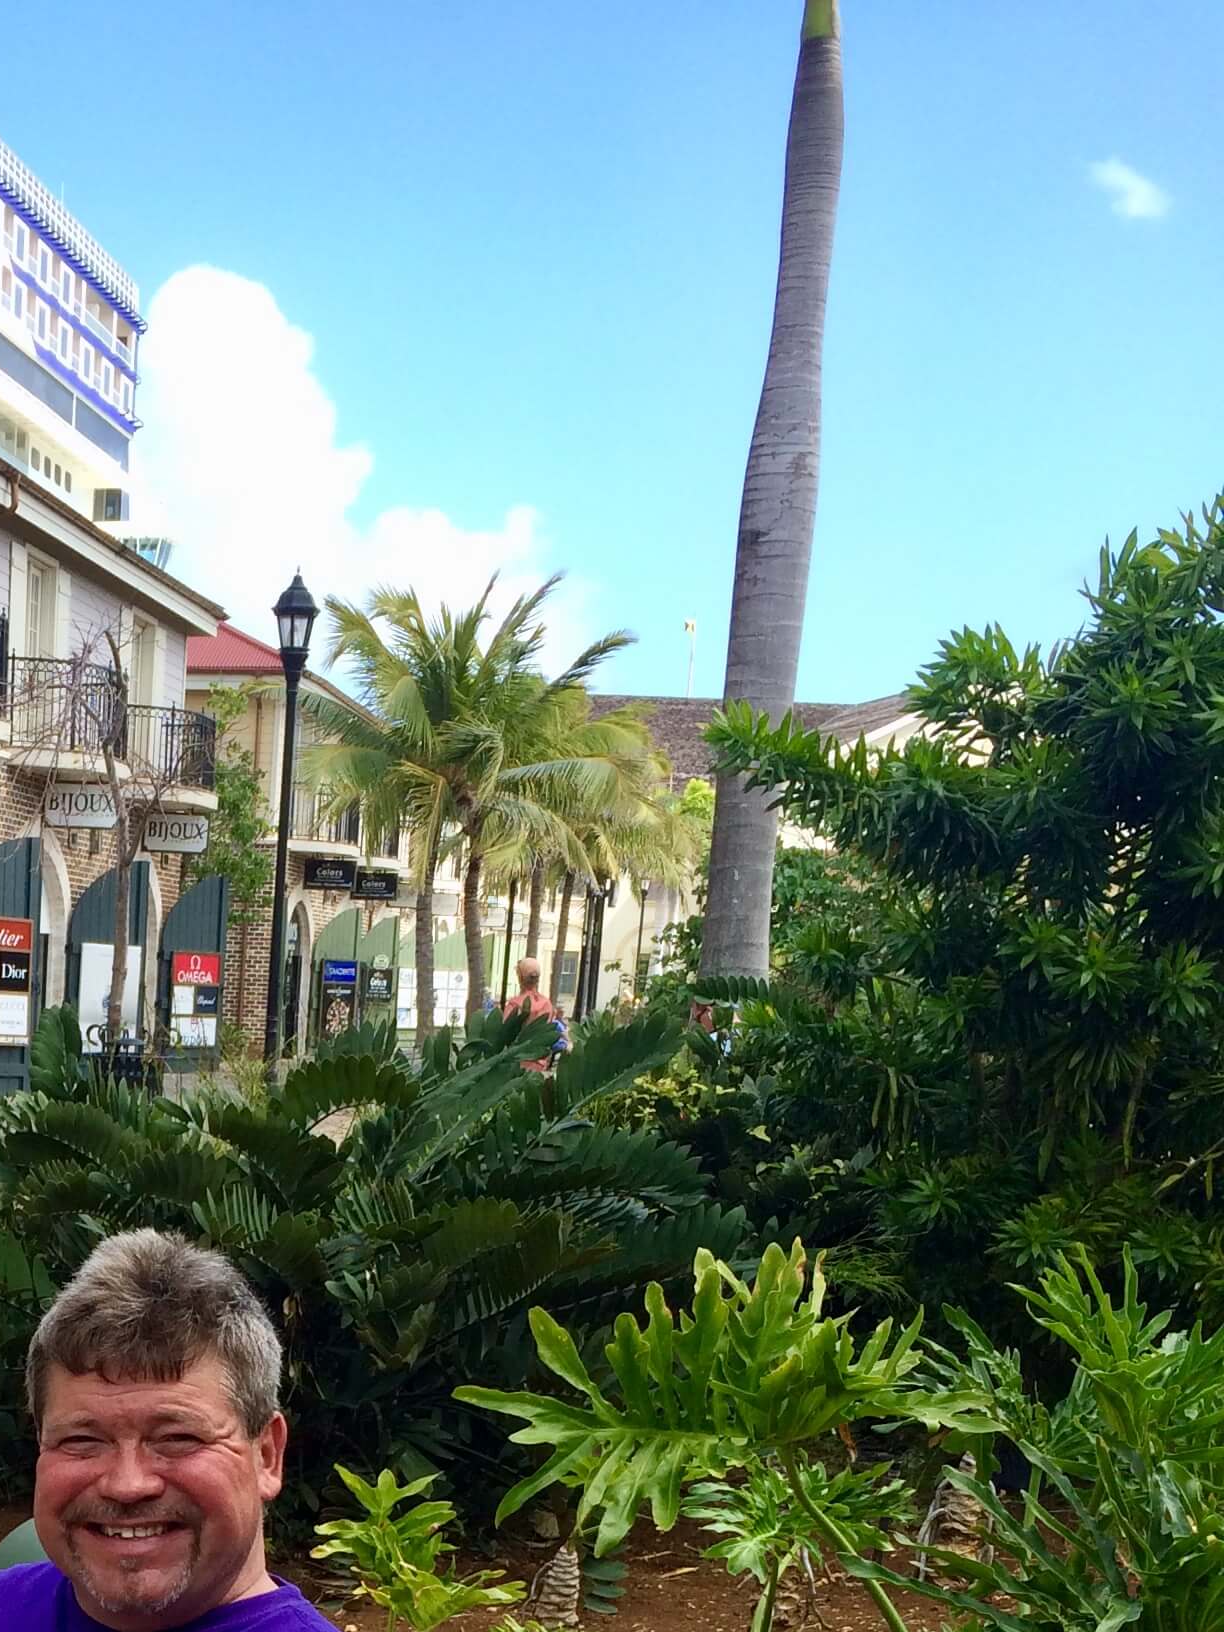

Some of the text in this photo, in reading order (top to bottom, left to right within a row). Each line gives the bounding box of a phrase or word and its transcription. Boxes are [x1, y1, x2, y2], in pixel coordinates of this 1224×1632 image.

[49, 793, 114, 815] BIJOUX
[148, 821, 205, 841] BIJOUX
[1, 963, 27, 980] Dior
[177, 970, 213, 984] OMEGA
